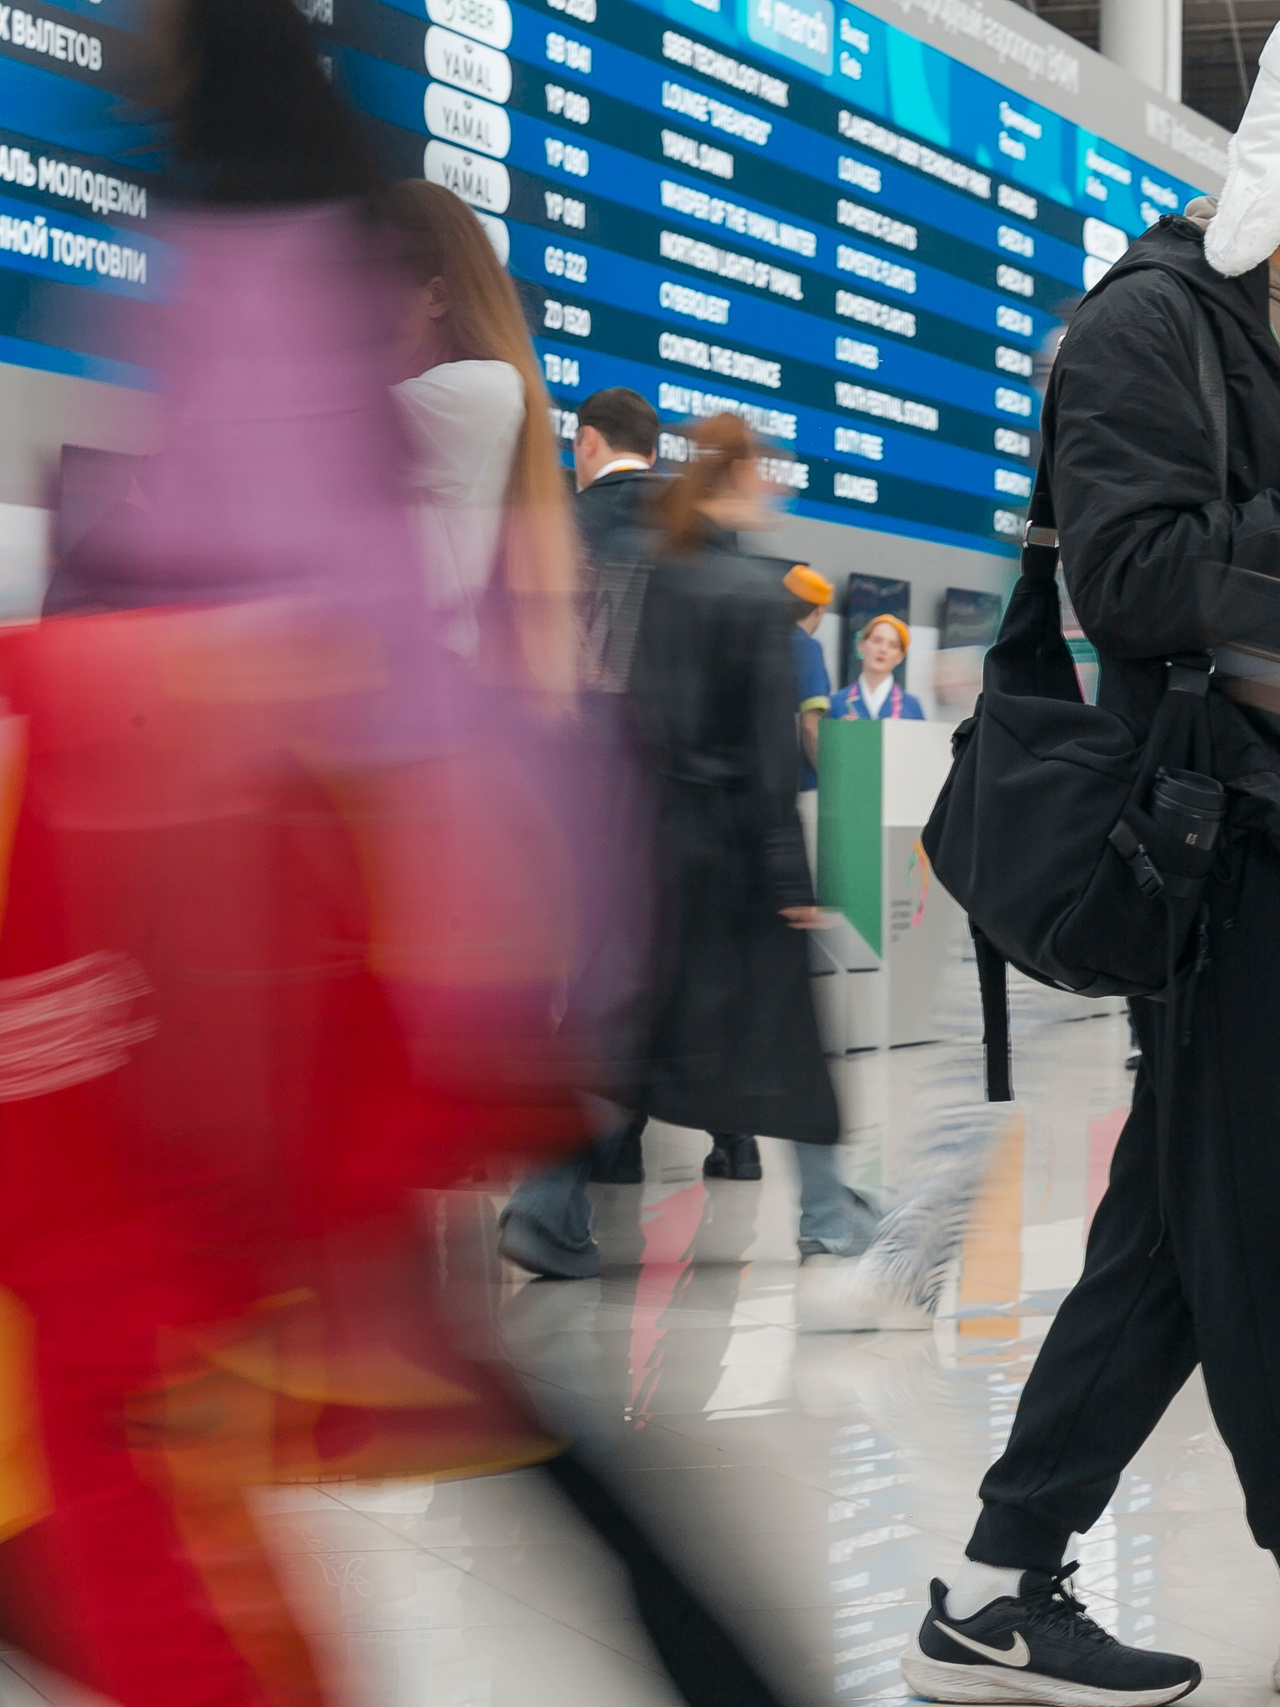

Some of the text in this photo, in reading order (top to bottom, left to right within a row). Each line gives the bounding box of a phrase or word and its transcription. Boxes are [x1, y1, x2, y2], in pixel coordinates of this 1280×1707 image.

[11, 9, 102, 71] ВЫЛЕТОВ
[443, 47, 493, 93] YAMAL
[442, 104, 493, 149] YAMAL
[38, 157, 147, 219] МОЛОДЕЖИ
[441, 160, 491, 207] YAMAL
[49, 227, 148, 285] ТОРГОВЛИ
